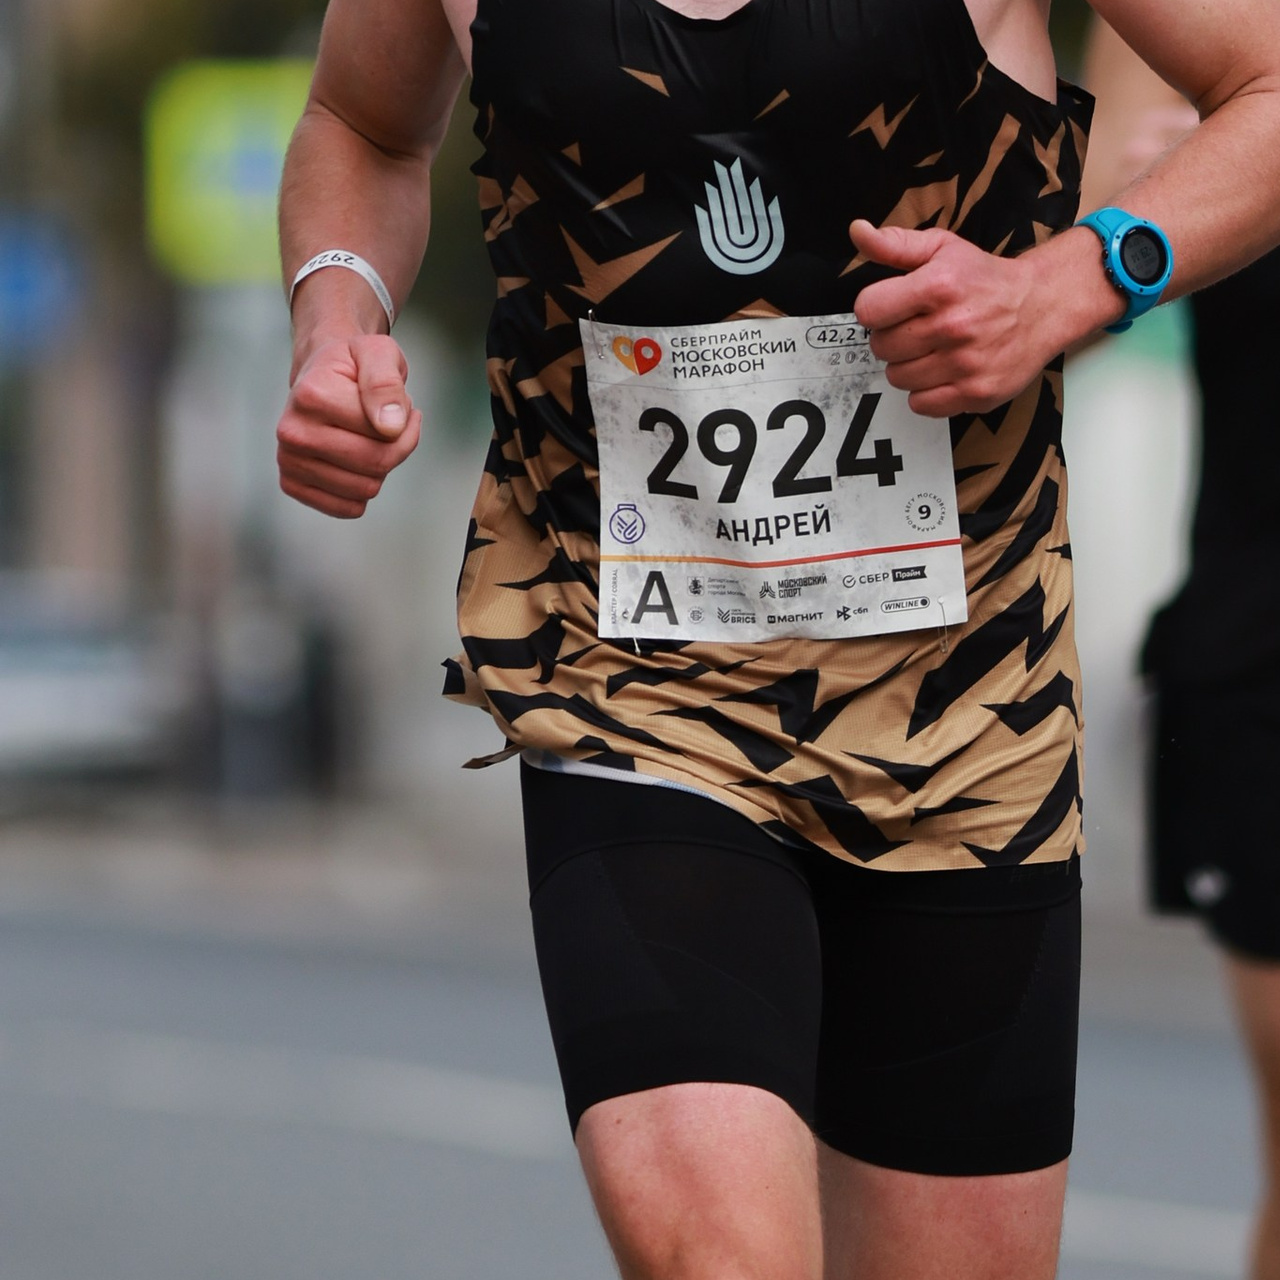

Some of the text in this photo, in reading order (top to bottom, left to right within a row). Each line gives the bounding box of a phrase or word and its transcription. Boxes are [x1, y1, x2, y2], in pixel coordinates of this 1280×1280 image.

[670, 329, 762, 348] СБЕРПРАЙМ
[817, 327, 856, 344] 42,2
[672, 339, 796, 363] МОСКОВСКИЙ
[830, 349, 870, 365] 202
[673, 358, 765, 379] МАРАФОН
[638, 393, 903, 504] 2924
[918, 504, 931, 520] 9
[715, 504, 832, 547] АНДРЕЙ
[777, 575, 827, 589] МОСКОВСКИЙ
[859, 569, 921, 584] СБЕР Прайм
[778, 588, 802, 599] СПОРТ
[884, 600, 919, 611] WINLINE
[731, 616, 756, 624] BRICS
